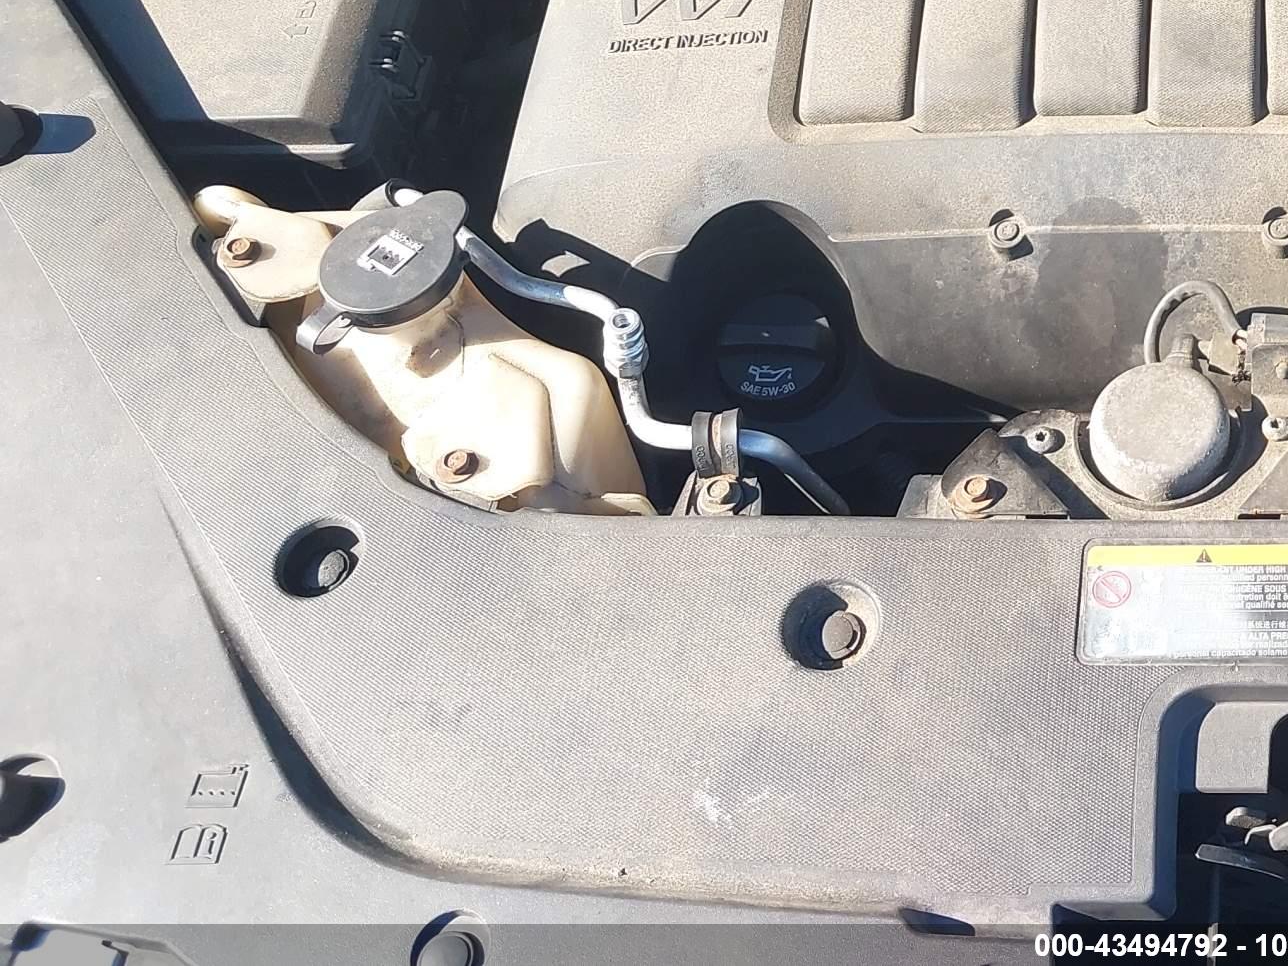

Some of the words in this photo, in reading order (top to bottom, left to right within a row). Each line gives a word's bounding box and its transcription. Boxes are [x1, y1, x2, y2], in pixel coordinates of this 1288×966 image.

[608, 35, 676, 54] DIRECT
[676, 30, 769, 49] INJECTION
[741, 381, 761, 395] SAE
[761, 381, 796, 396] 5W-30
[1264, 584, 1287, 593] SOUS
[1265, 592, 1282, 601] doit
